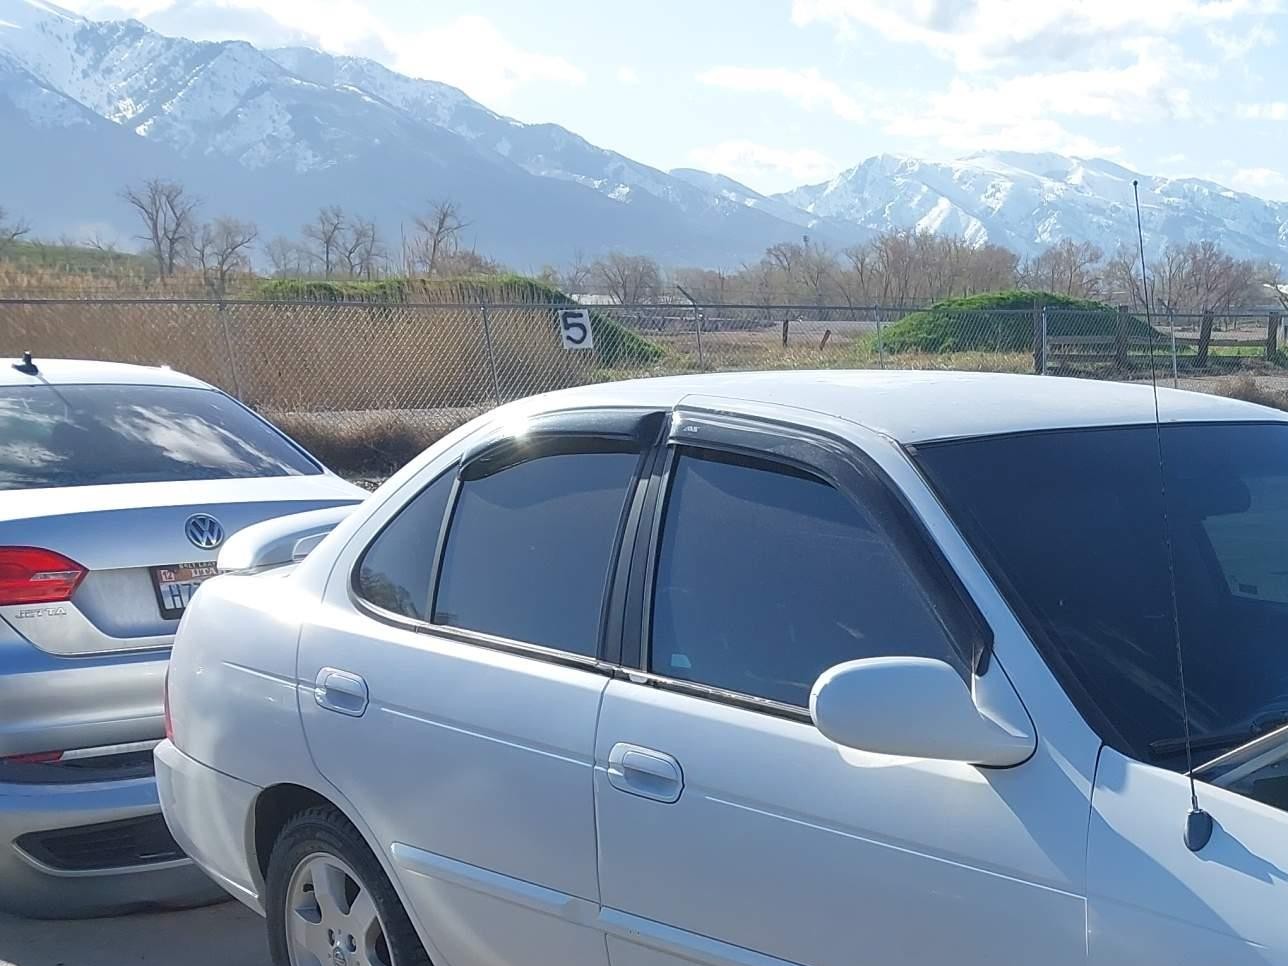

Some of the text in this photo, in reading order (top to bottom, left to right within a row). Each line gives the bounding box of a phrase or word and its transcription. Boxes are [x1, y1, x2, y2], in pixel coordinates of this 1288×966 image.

[562, 312, 587, 344] 5
[192, 567, 217, 577] UTA
[15, 607, 67, 619] JETTA
